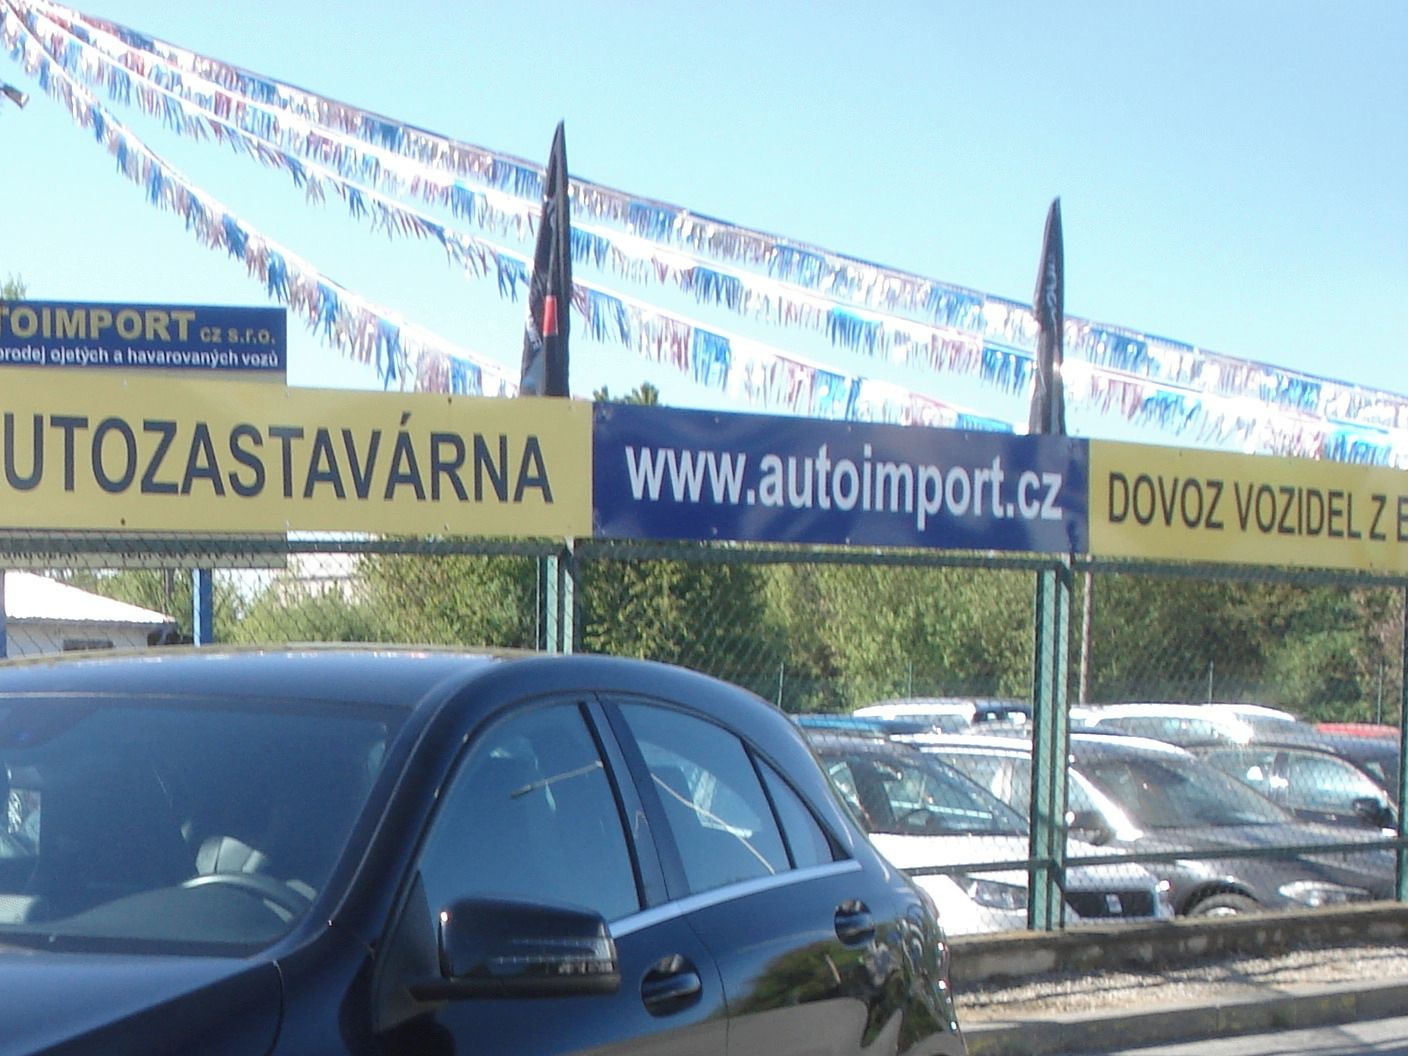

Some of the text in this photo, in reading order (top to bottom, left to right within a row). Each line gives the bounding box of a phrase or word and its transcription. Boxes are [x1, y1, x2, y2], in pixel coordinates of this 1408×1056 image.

[50, 347, 110, 367] ojetých
[114, 350, 124, 364] a
[127, 347, 239, 369] havarovaných
[241, 350, 280, 368] vozů
[200, 326, 222, 344] cz
[227, 327, 276, 345] s.r.o.
[624, 444, 1064, 532] www.autoimport.cz
[1108, 470, 1225, 531] DOVOZ
[1233, 480, 1362, 541] VOZIDEL
[1368, 492, 1388, 543] Z
